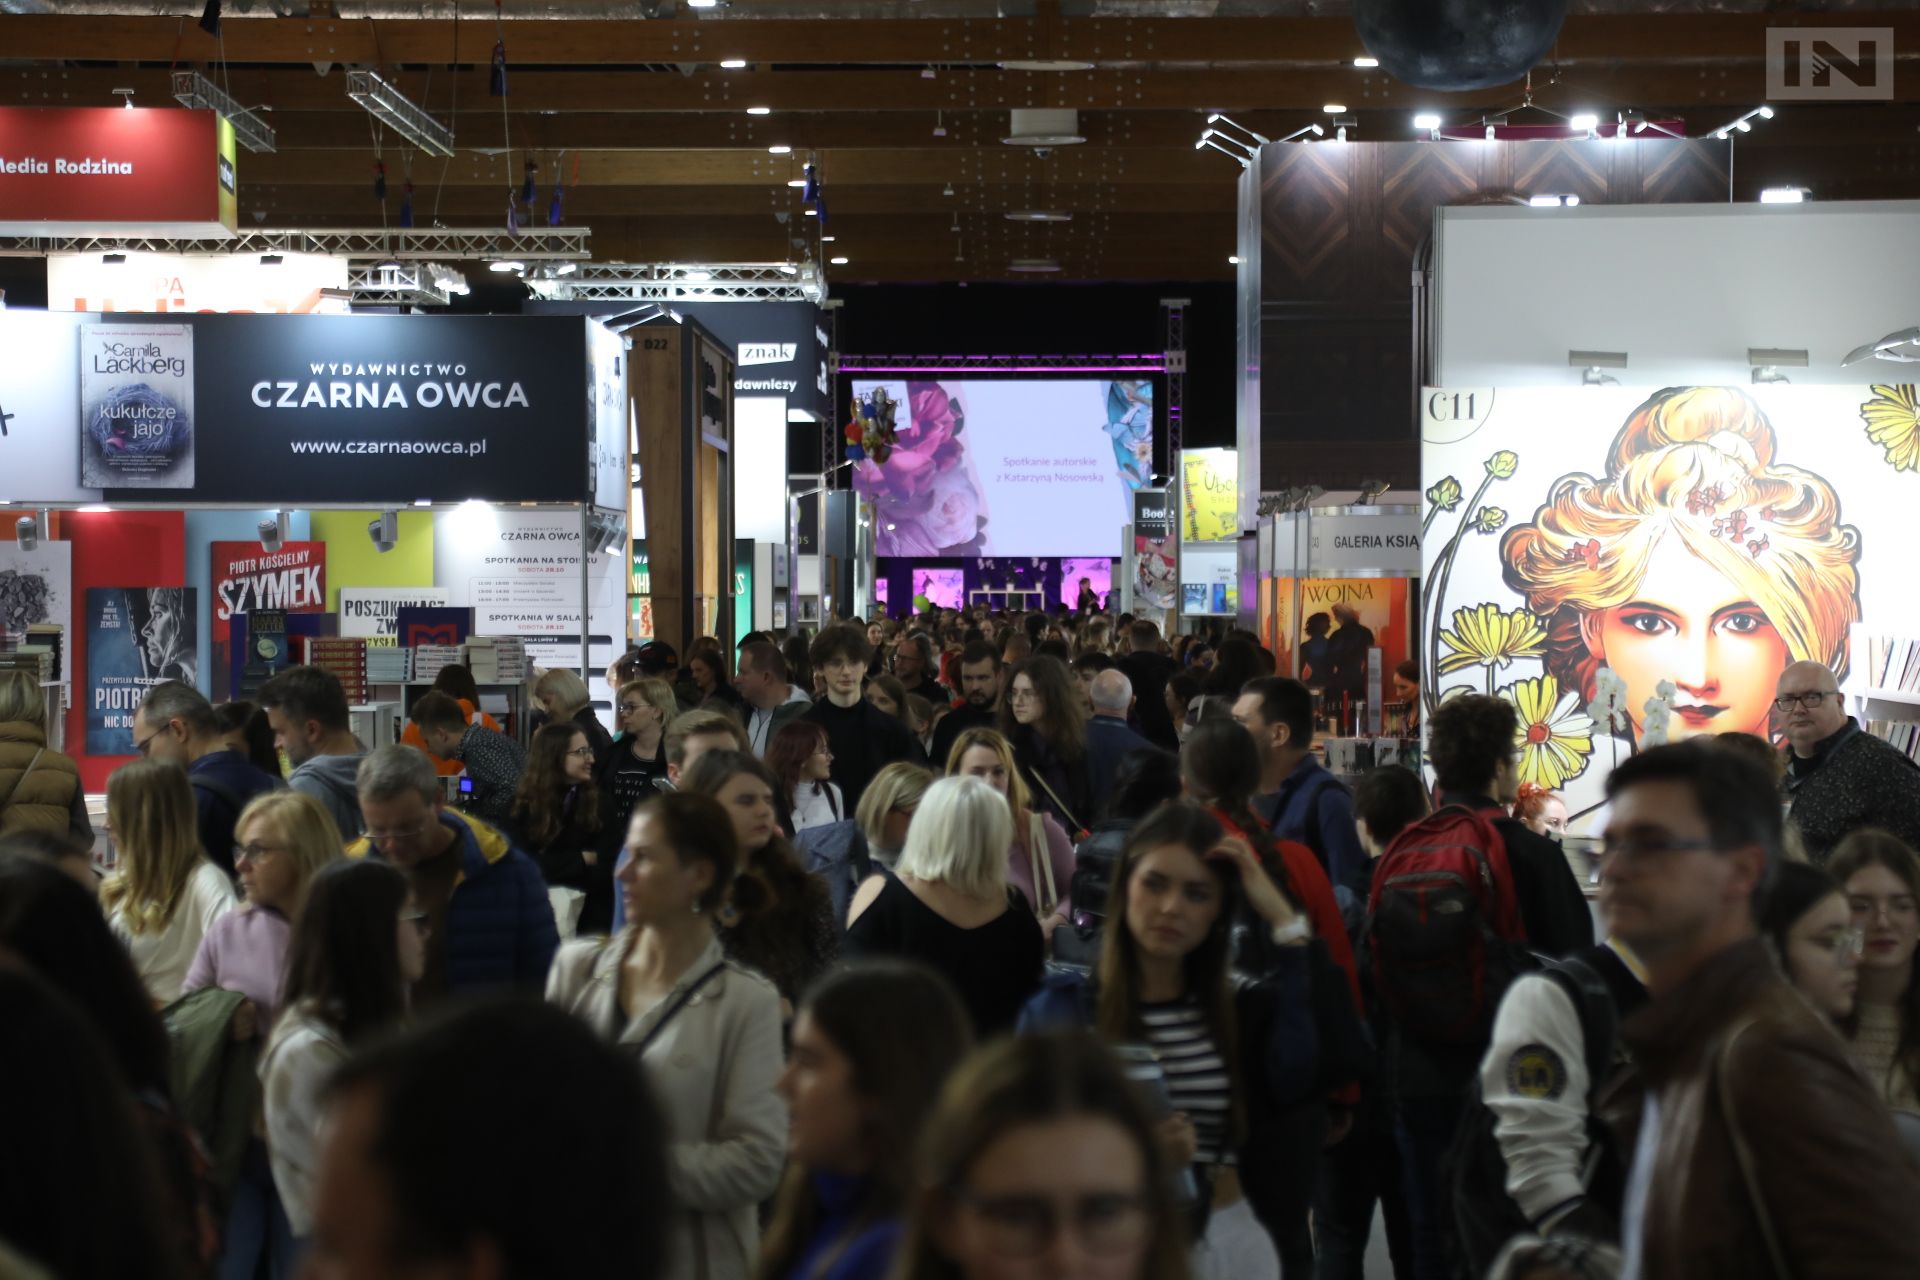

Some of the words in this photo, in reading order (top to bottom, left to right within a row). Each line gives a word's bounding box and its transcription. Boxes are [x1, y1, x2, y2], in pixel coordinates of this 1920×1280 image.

[55, 158, 133, 175] Rodzina
[112, 342, 161, 357] Camilla
[644, 339, 668, 350] D22
[744, 344, 790, 359] znak
[94, 355, 185, 377] Läckberg
[310, 364, 466, 376] WYDAWNICTWO
[251, 382, 409, 408] CZARNA
[416, 382, 530, 408] OWCA
[100, 404, 176, 419] kukułcze
[1429, 391, 1476, 422] C11
[133, 420, 164, 439] jajo
[290, 439, 487, 457] www.czarnaowca.pl
[1003, 457, 1051, 467] Spotkanie
[1053, 457, 1097, 467] autorskie
[1004, 473, 1052, 483] Katarzyną
[1054, 473, 1105, 483] Nosowską
[501, 532, 547, 541] CZARNA
[548, 532, 580, 541] OWCA
[1334, 536, 1383, 548] GALERIA
[229, 558, 257, 575] PIOTR
[259, 550, 310, 570] KOŚCIELNY
[217, 565, 323, 621] SZYMEK
[1307, 583, 1374, 605] WOJNA
[104, 716, 120, 728] NIC
